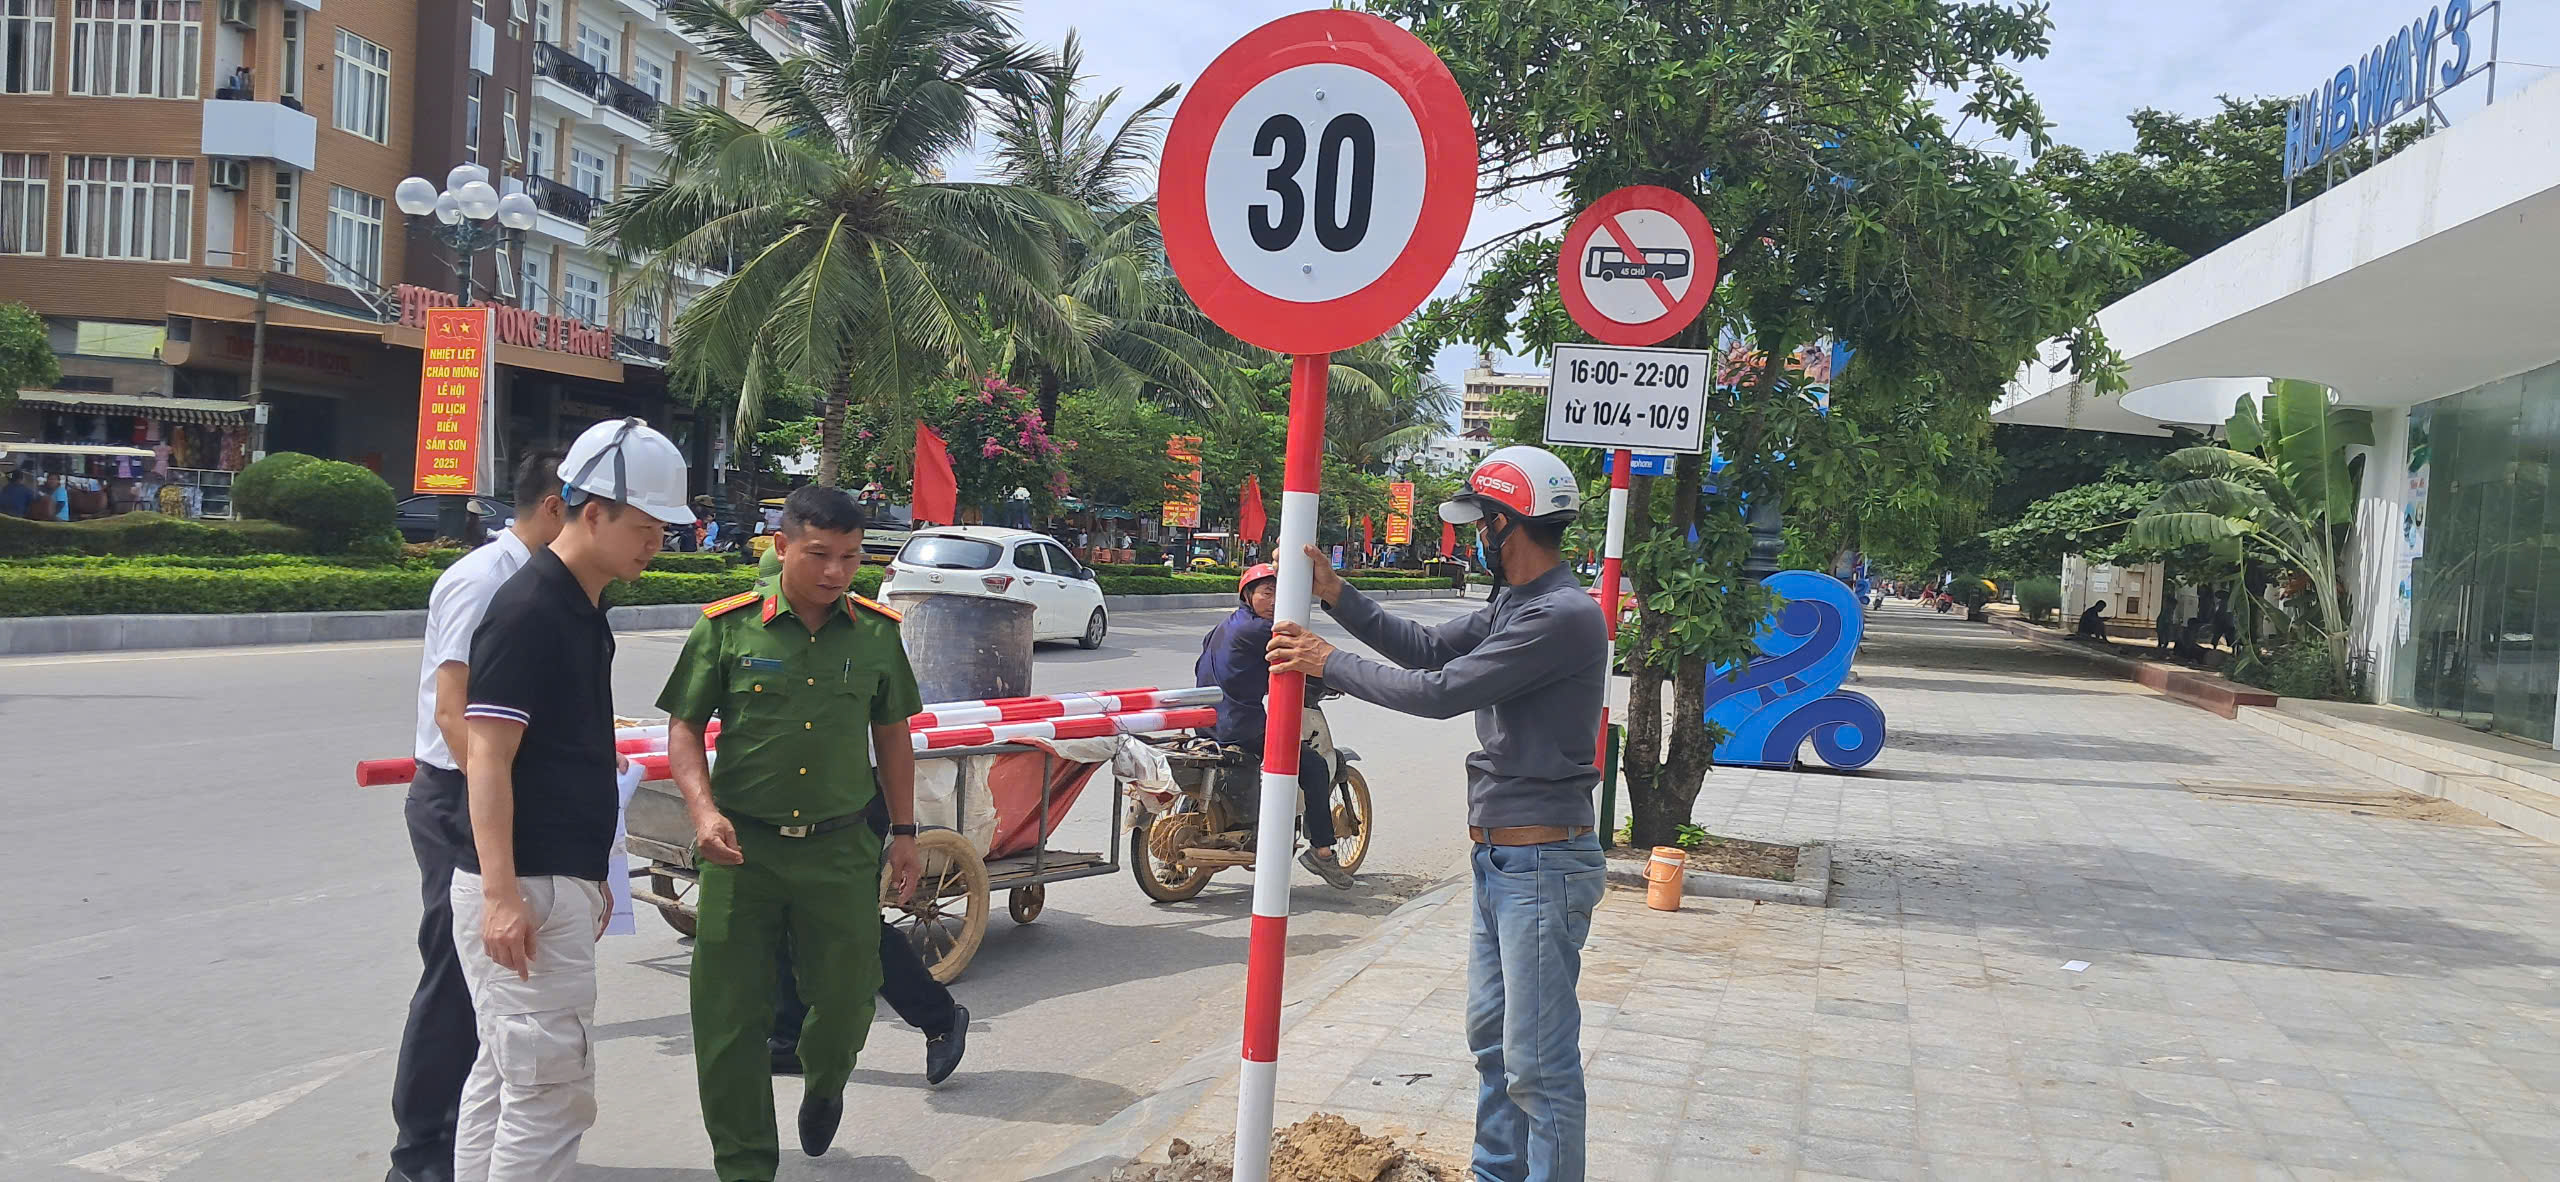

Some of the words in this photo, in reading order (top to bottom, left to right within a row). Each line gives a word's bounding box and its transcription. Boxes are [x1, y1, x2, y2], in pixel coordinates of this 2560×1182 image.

[2283, 5, 2439, 183] HUBWAY
[2441, 0, 2473, 87] 3
[1248, 113, 1375, 253] 30
[1620, 267, 1630, 276] 45
[430, 346, 456, 362] NHIỆT
[457, 346, 477, 362] LIỆT
[426, 364, 450, 378] CHÀO
[1633, 362, 1690, 389] 22:00
[450, 382, 465, 398] HỘI
[431, 403, 444, 414] DU
[446, 403, 466, 416] LỊCH
[1565, 398, 1587, 424] từ
[1593, 401, 1632, 427] 10/4
[433, 457, 458, 469] 2025!
[1475, 475, 1516, 495] ROSSI
